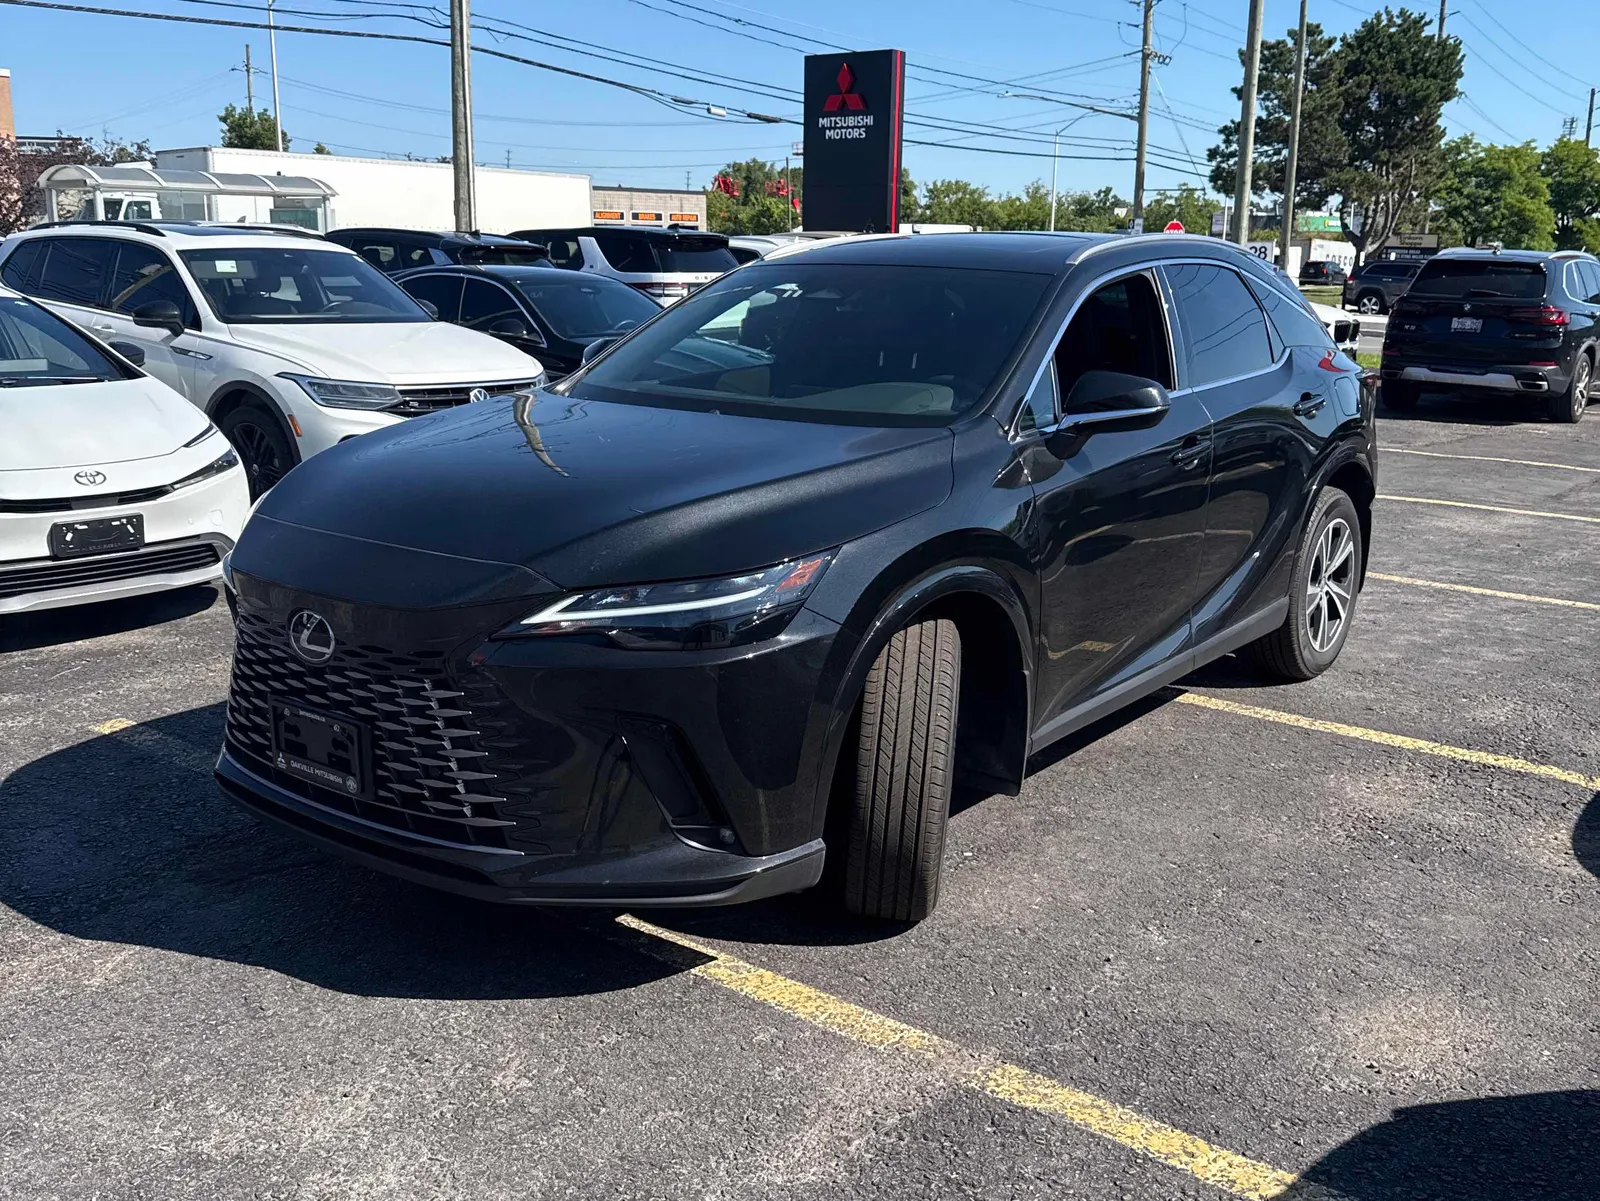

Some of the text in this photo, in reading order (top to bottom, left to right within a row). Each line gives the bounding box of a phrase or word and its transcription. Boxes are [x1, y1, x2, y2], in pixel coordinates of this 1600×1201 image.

[818, 115, 874, 128] MITSUBISHI
[825, 128, 866, 139] MOTORS
[595, 211, 621, 219] ALIGNMENT
[638, 212, 656, 220] BRAKES
[290, 760, 314, 774] OAKVILLE
[314, 768, 343, 784] MITSUBISHI
